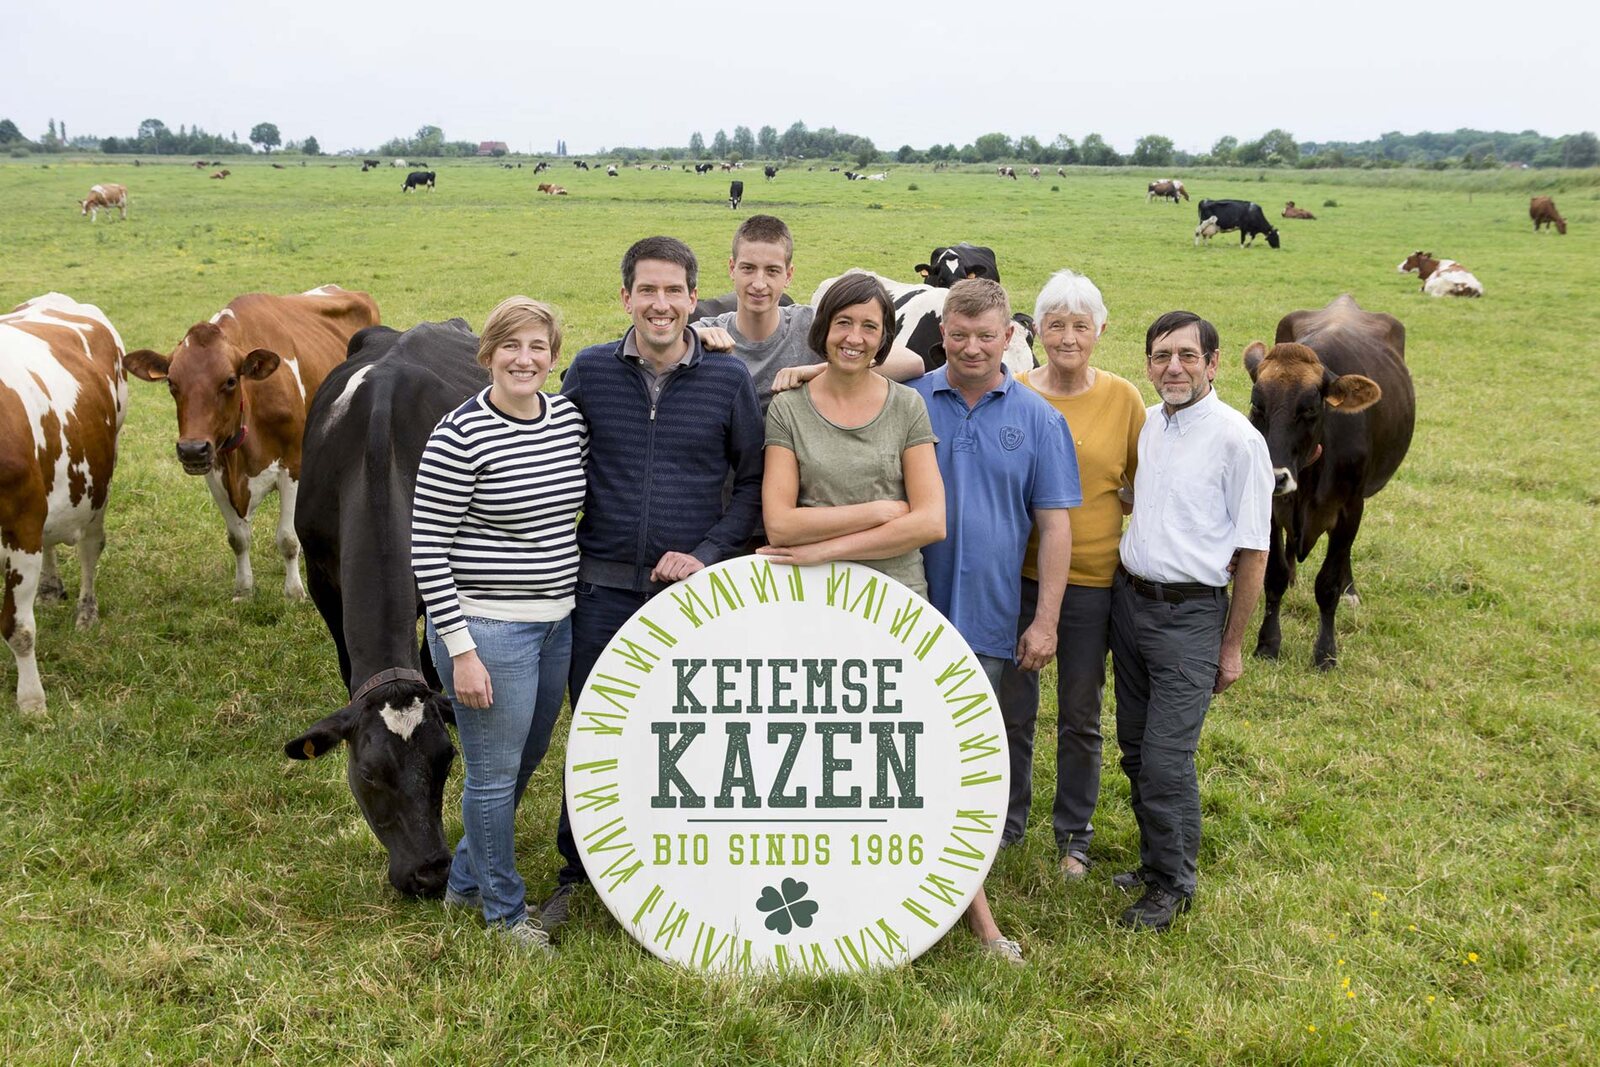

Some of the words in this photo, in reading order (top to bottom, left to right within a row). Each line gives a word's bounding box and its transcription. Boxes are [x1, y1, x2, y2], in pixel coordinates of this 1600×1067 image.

[671, 658, 903, 714] KEIEMSE
[651, 721, 924, 809] KAZEN
[653, 833, 709, 866] BIO
[729, 833, 831, 866] SINDS
[851, 833, 924, 866] 1986
